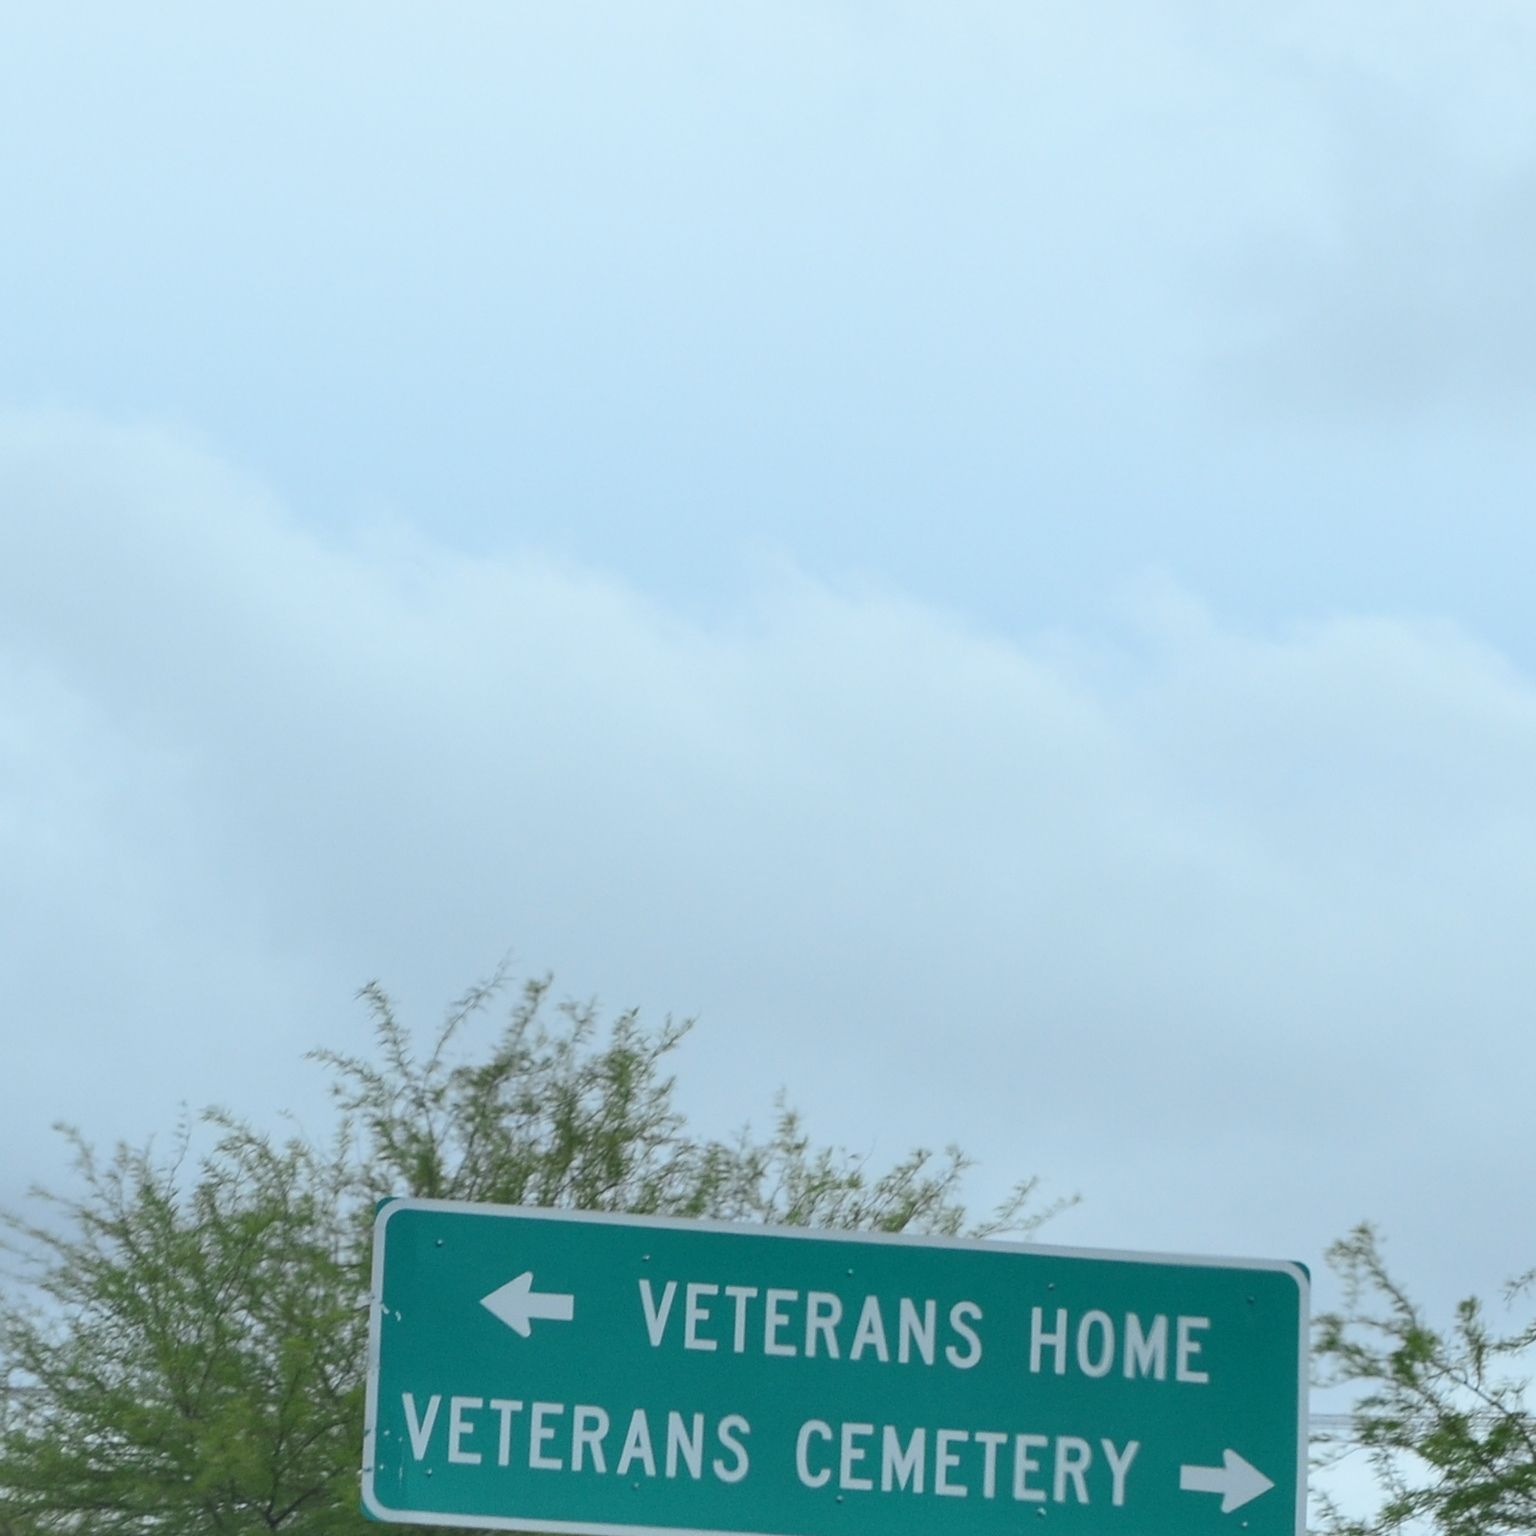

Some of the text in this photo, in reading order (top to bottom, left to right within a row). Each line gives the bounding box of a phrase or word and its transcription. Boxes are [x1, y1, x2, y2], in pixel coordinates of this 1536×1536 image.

[638, 1279, 1211, 1383] VETERANS HOME
[402, 1392, 1140, 1506] VETERANS CEMETERY
